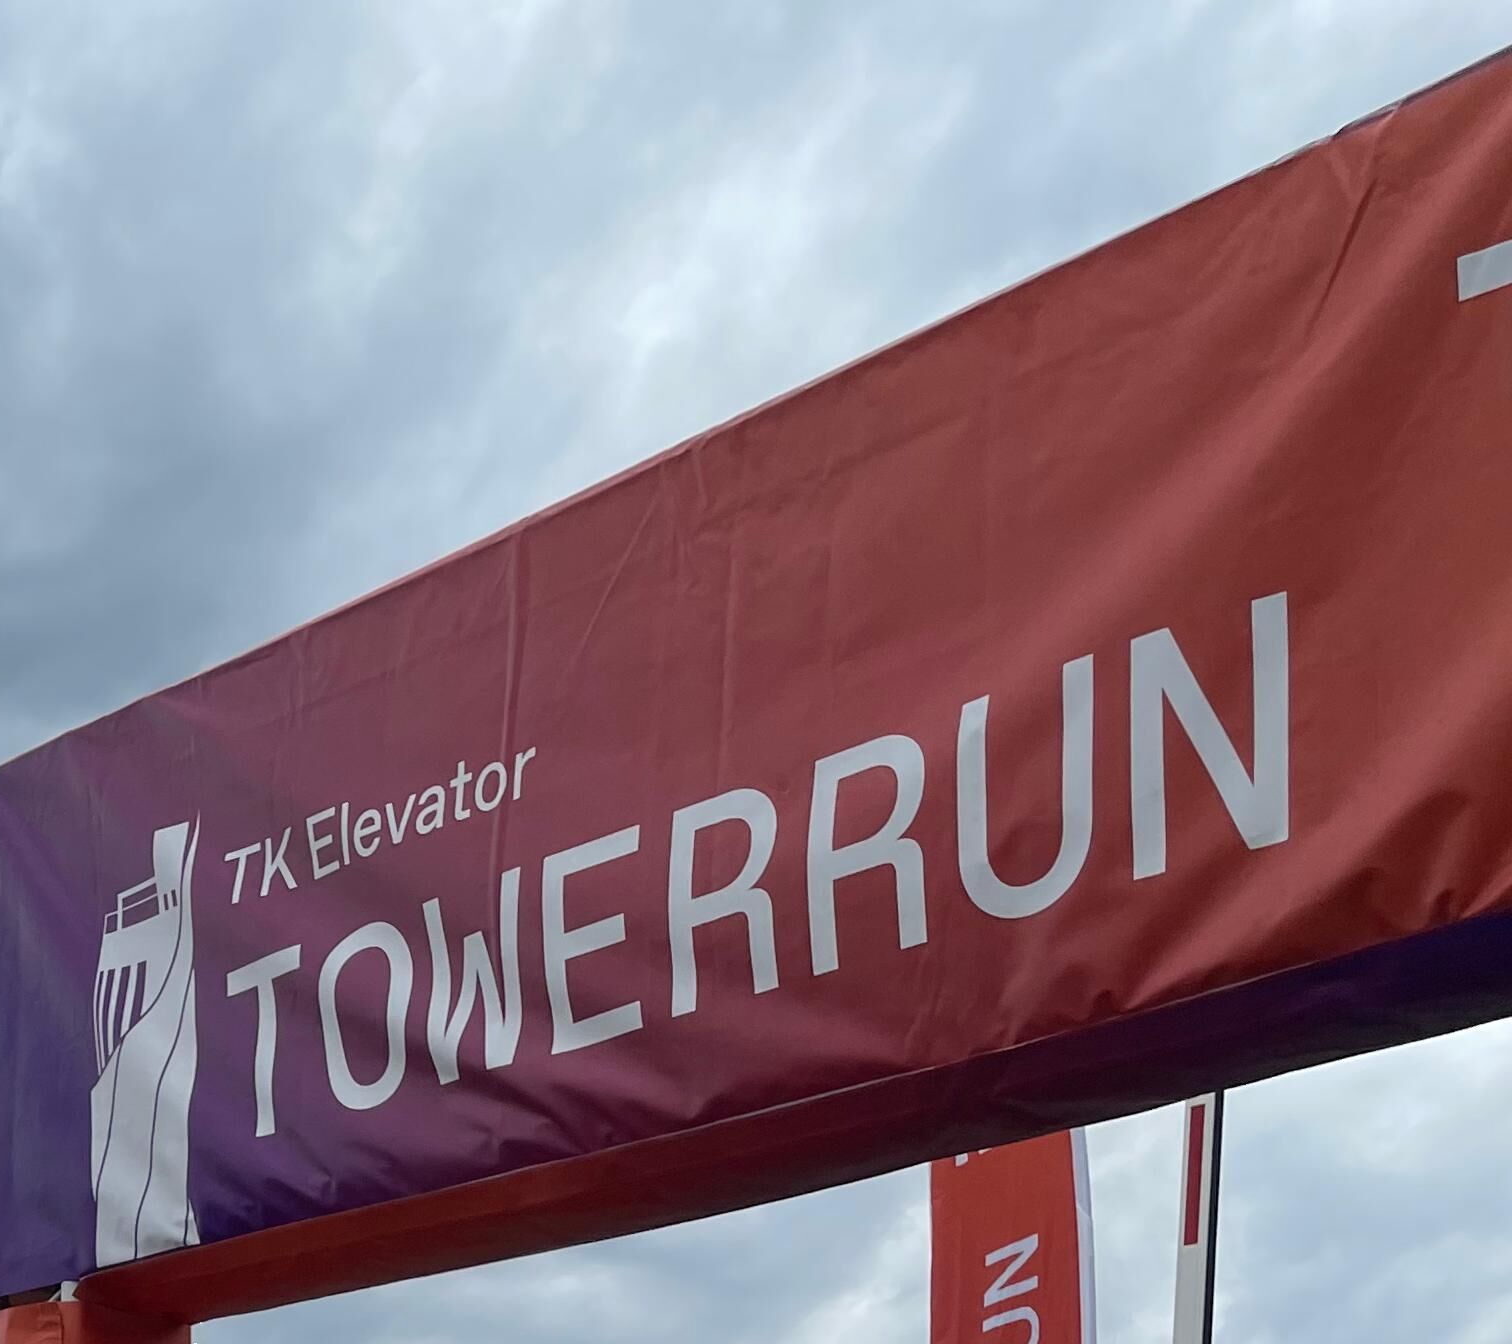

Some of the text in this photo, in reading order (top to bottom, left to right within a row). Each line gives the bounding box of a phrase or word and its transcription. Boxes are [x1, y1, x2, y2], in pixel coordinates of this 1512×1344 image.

[223, 745, 537, 905] TK Elevator
[225, 591, 1289, 1140] TOWERRUN
